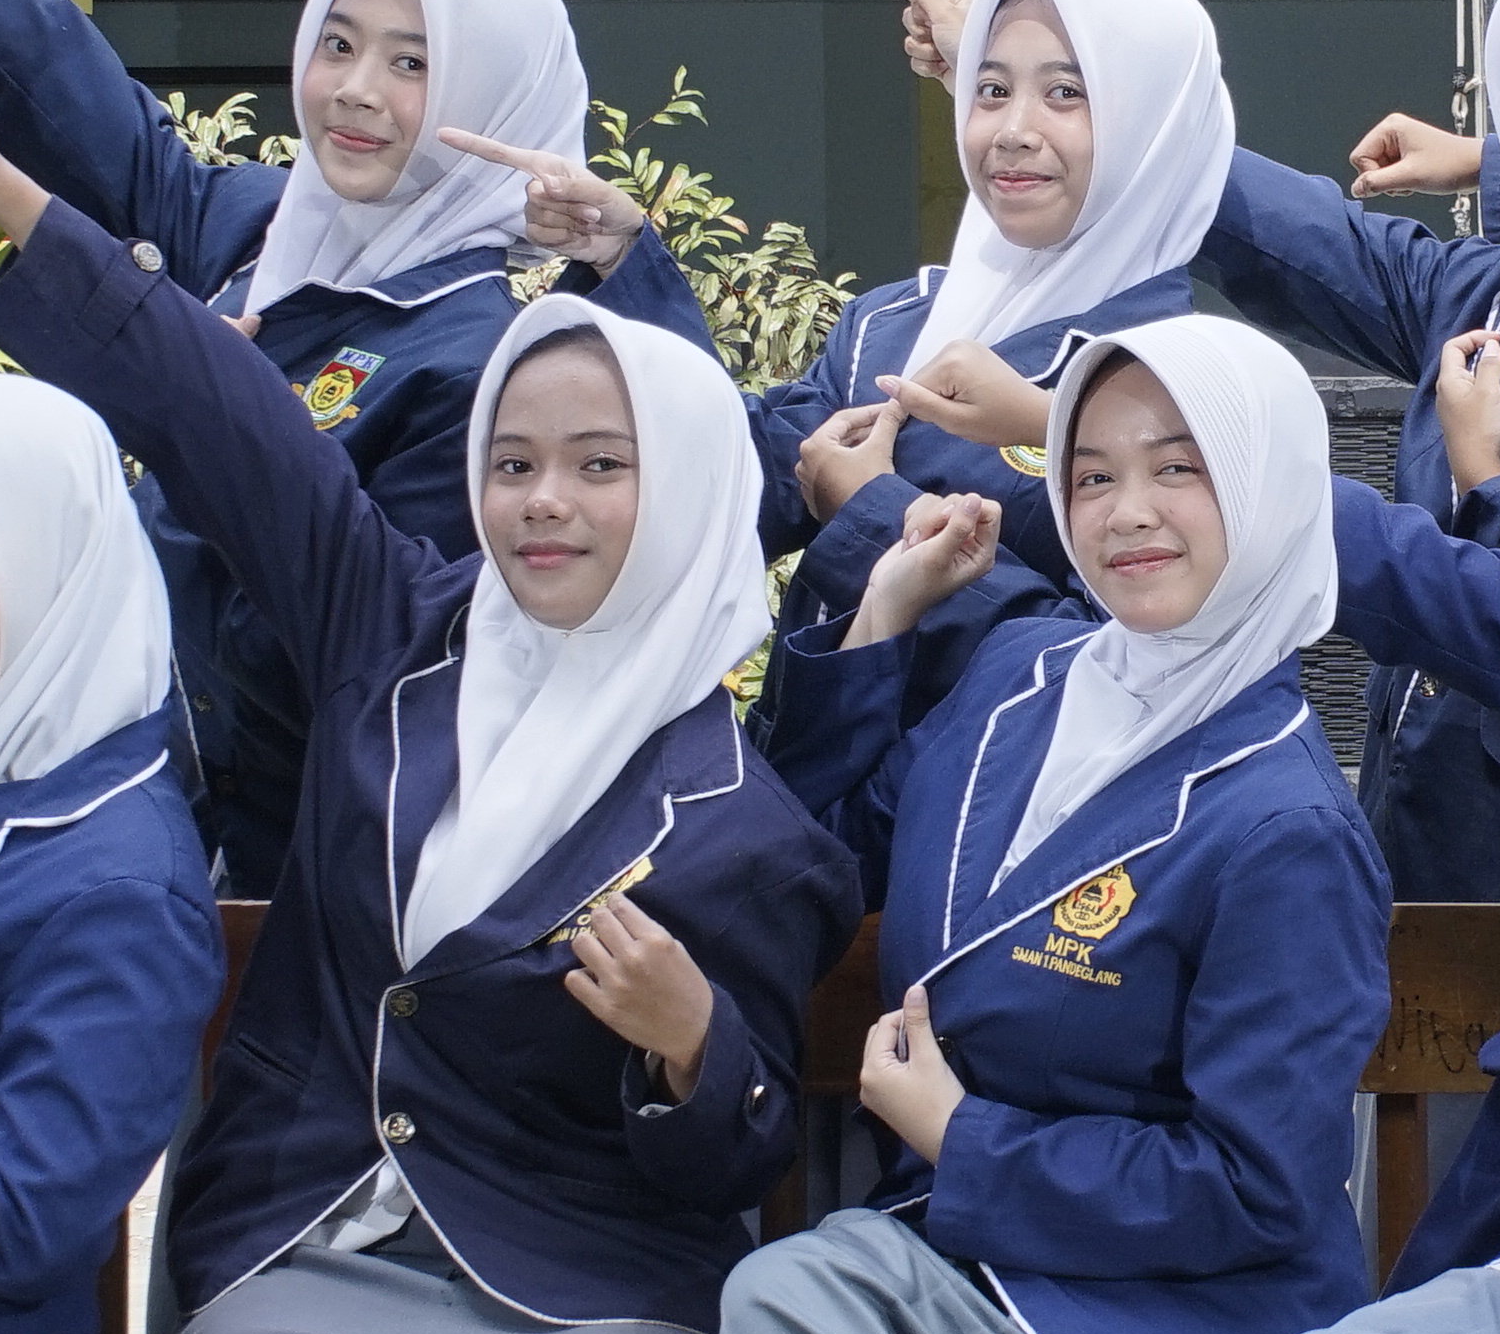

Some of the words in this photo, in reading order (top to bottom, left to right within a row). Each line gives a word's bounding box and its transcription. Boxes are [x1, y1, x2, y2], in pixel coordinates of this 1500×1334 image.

[1011, 946, 1042, 968] SMAN
[1049, 955, 1123, 987] PANDEGLANG
[1044, 932, 1095, 966] MPK
